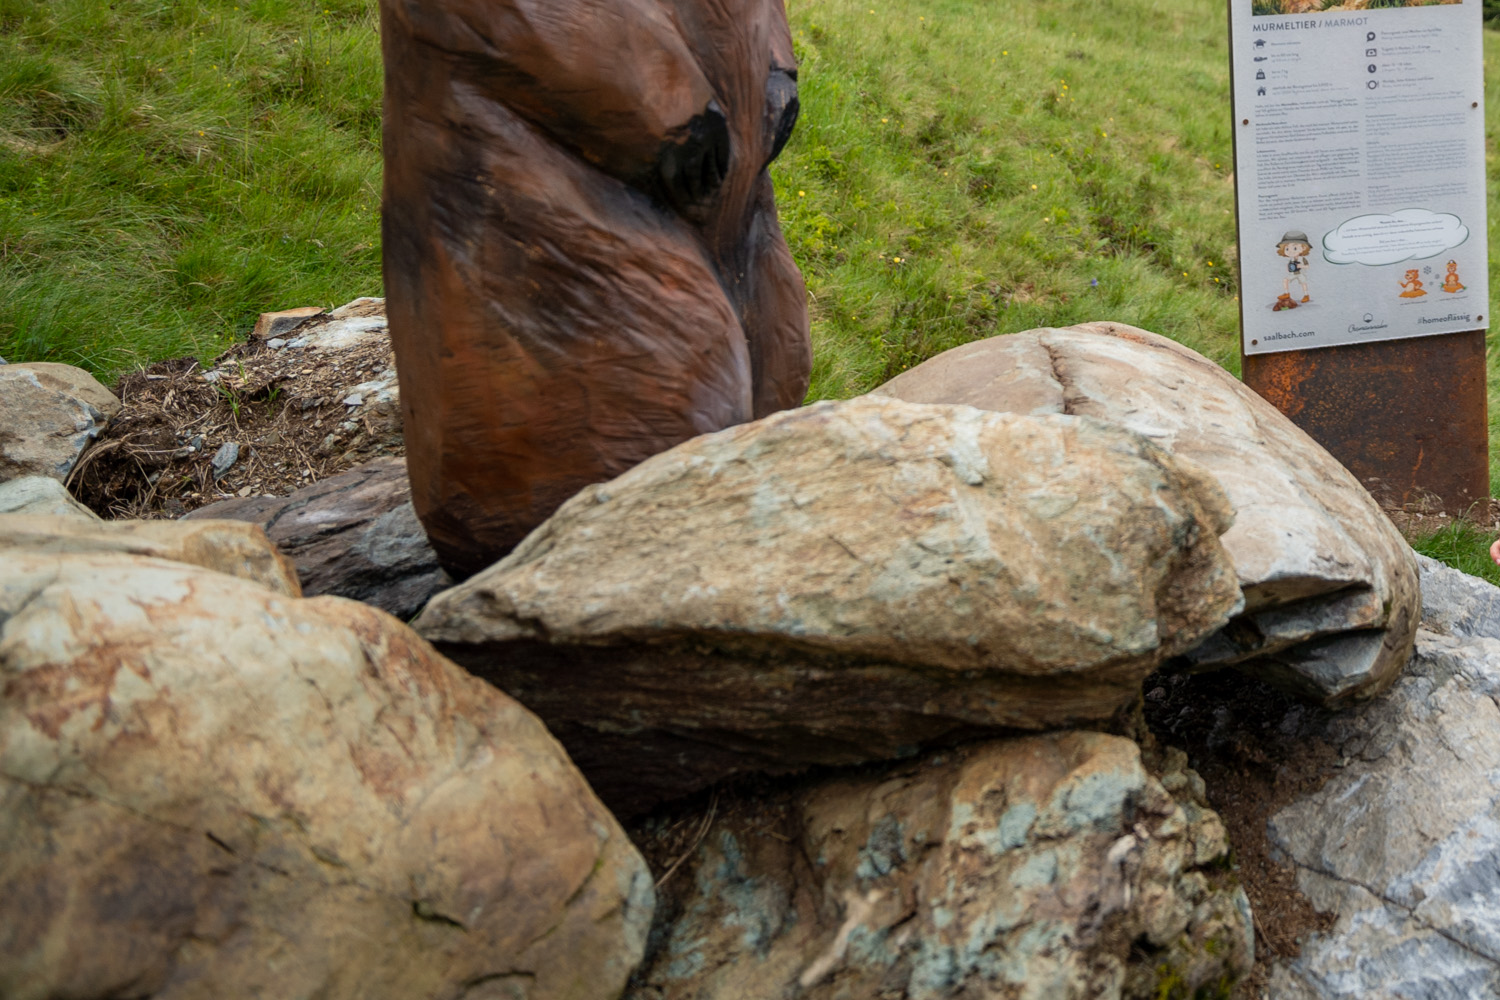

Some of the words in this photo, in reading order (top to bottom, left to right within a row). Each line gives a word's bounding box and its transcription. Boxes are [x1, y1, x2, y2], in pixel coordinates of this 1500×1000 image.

[1252, 20, 1317, 33] MURMELTIER
[1324, 17, 1369, 28] MARMOT
[1264, 331, 1315, 341] saalbach.com
